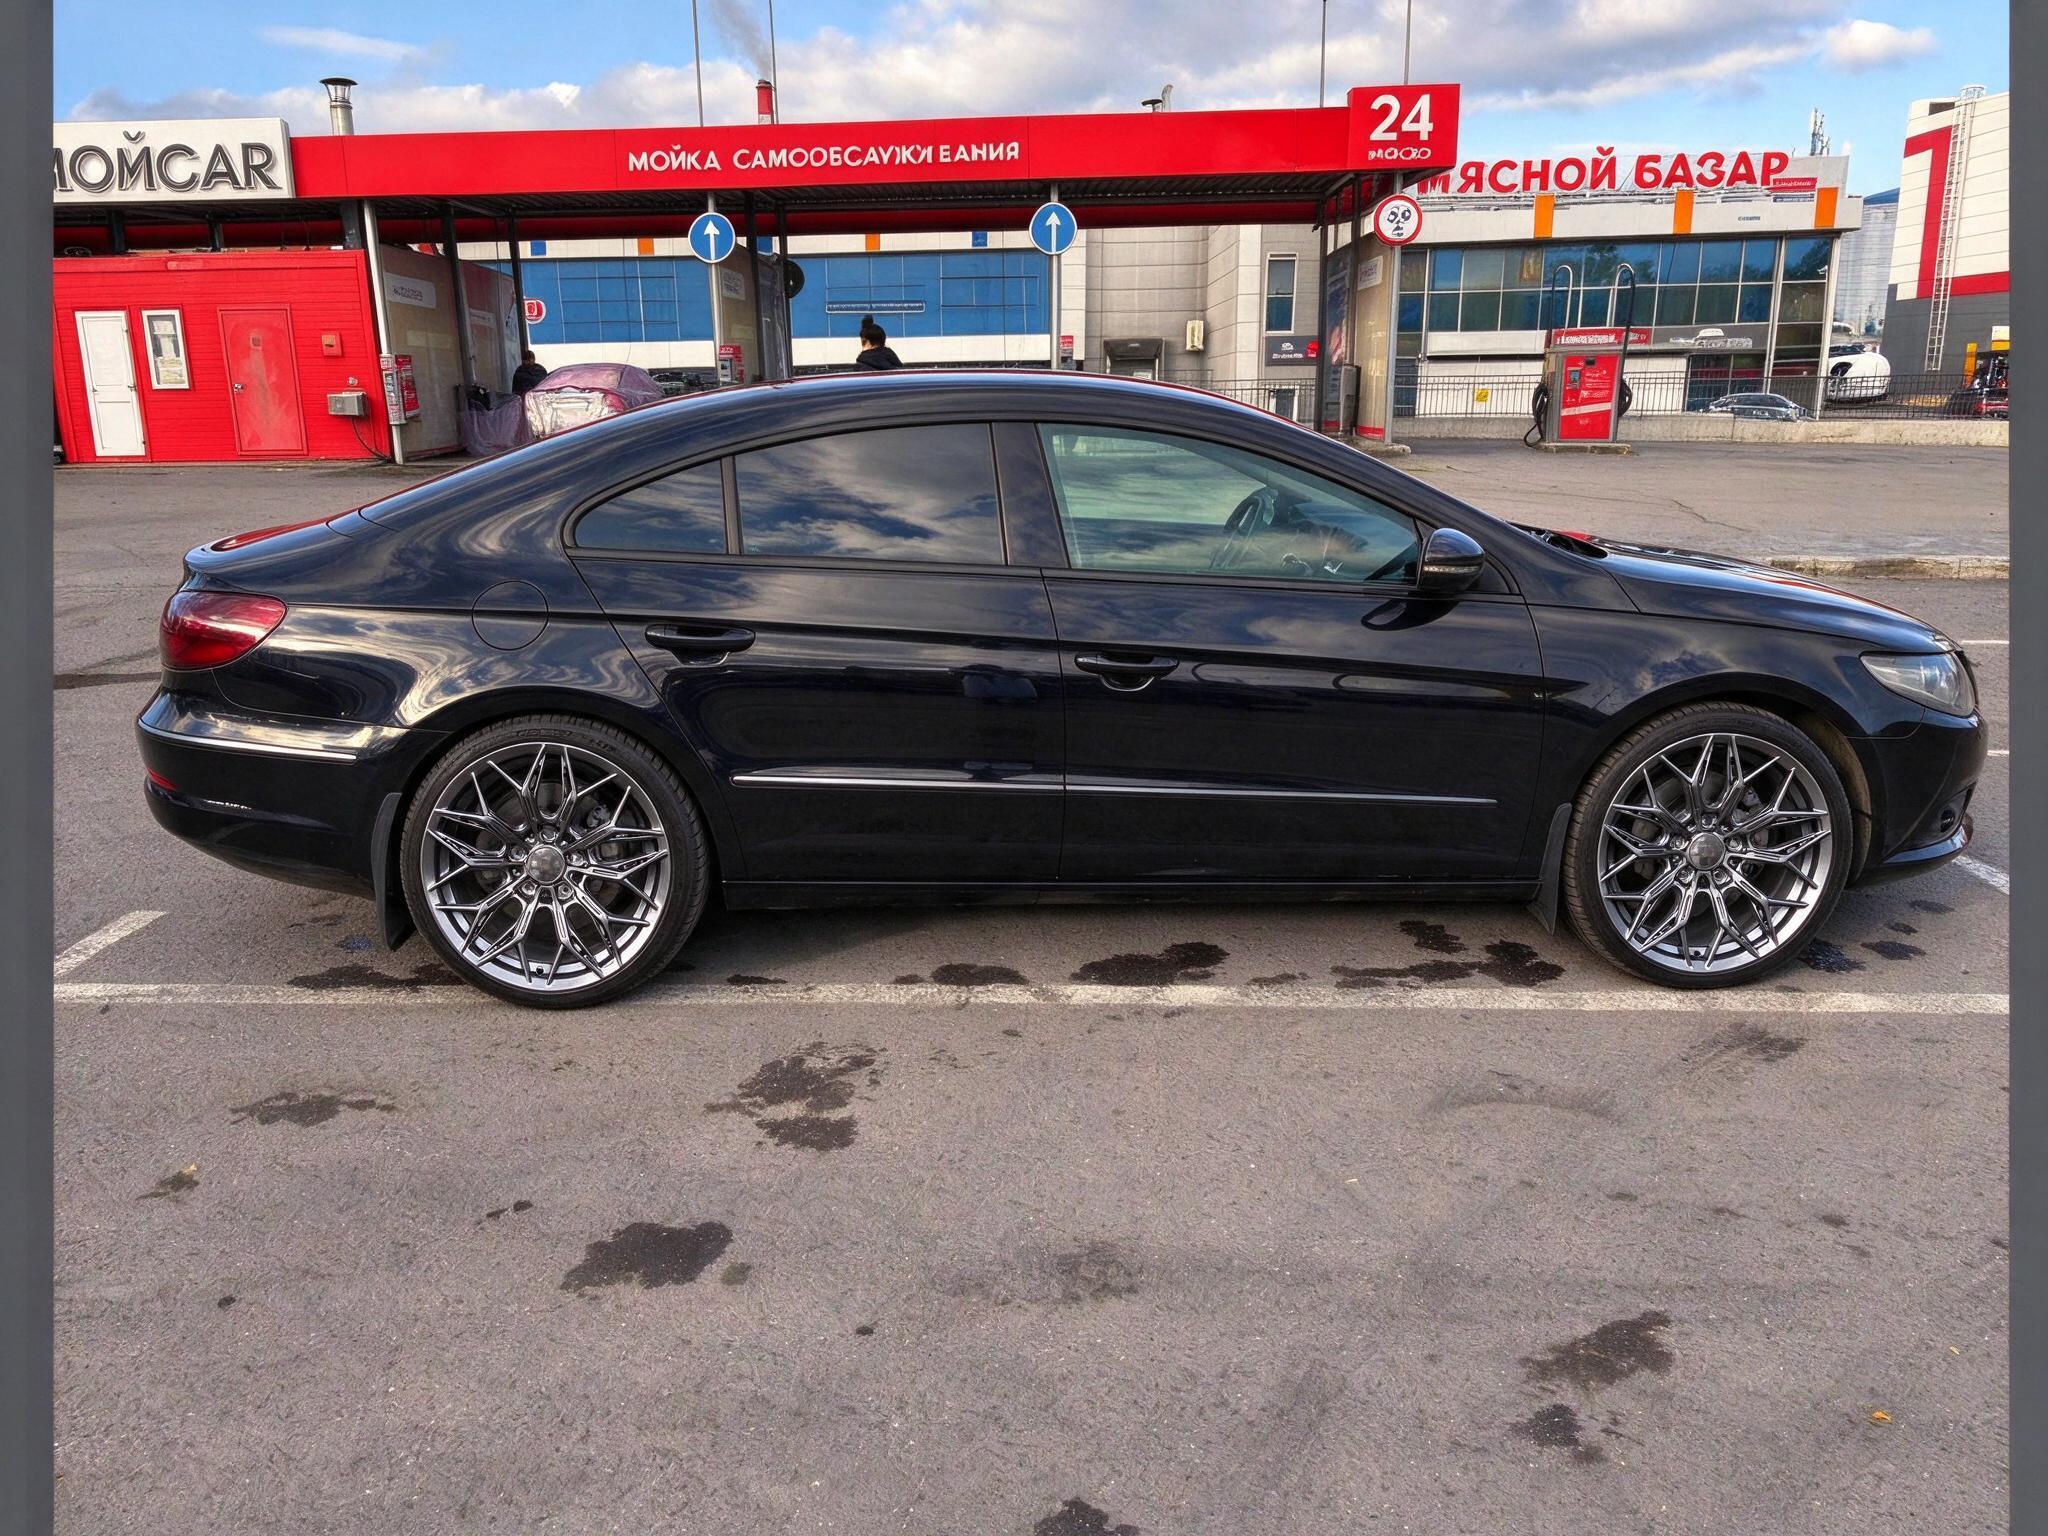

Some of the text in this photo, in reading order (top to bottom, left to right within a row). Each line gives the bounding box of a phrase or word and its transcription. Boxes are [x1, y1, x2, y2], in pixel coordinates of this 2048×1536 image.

[1369, 93, 1434, 141] 24
[628, 144, 722, 172] МОЙКА
[1634, 150, 1789, 189] БАЗАР
